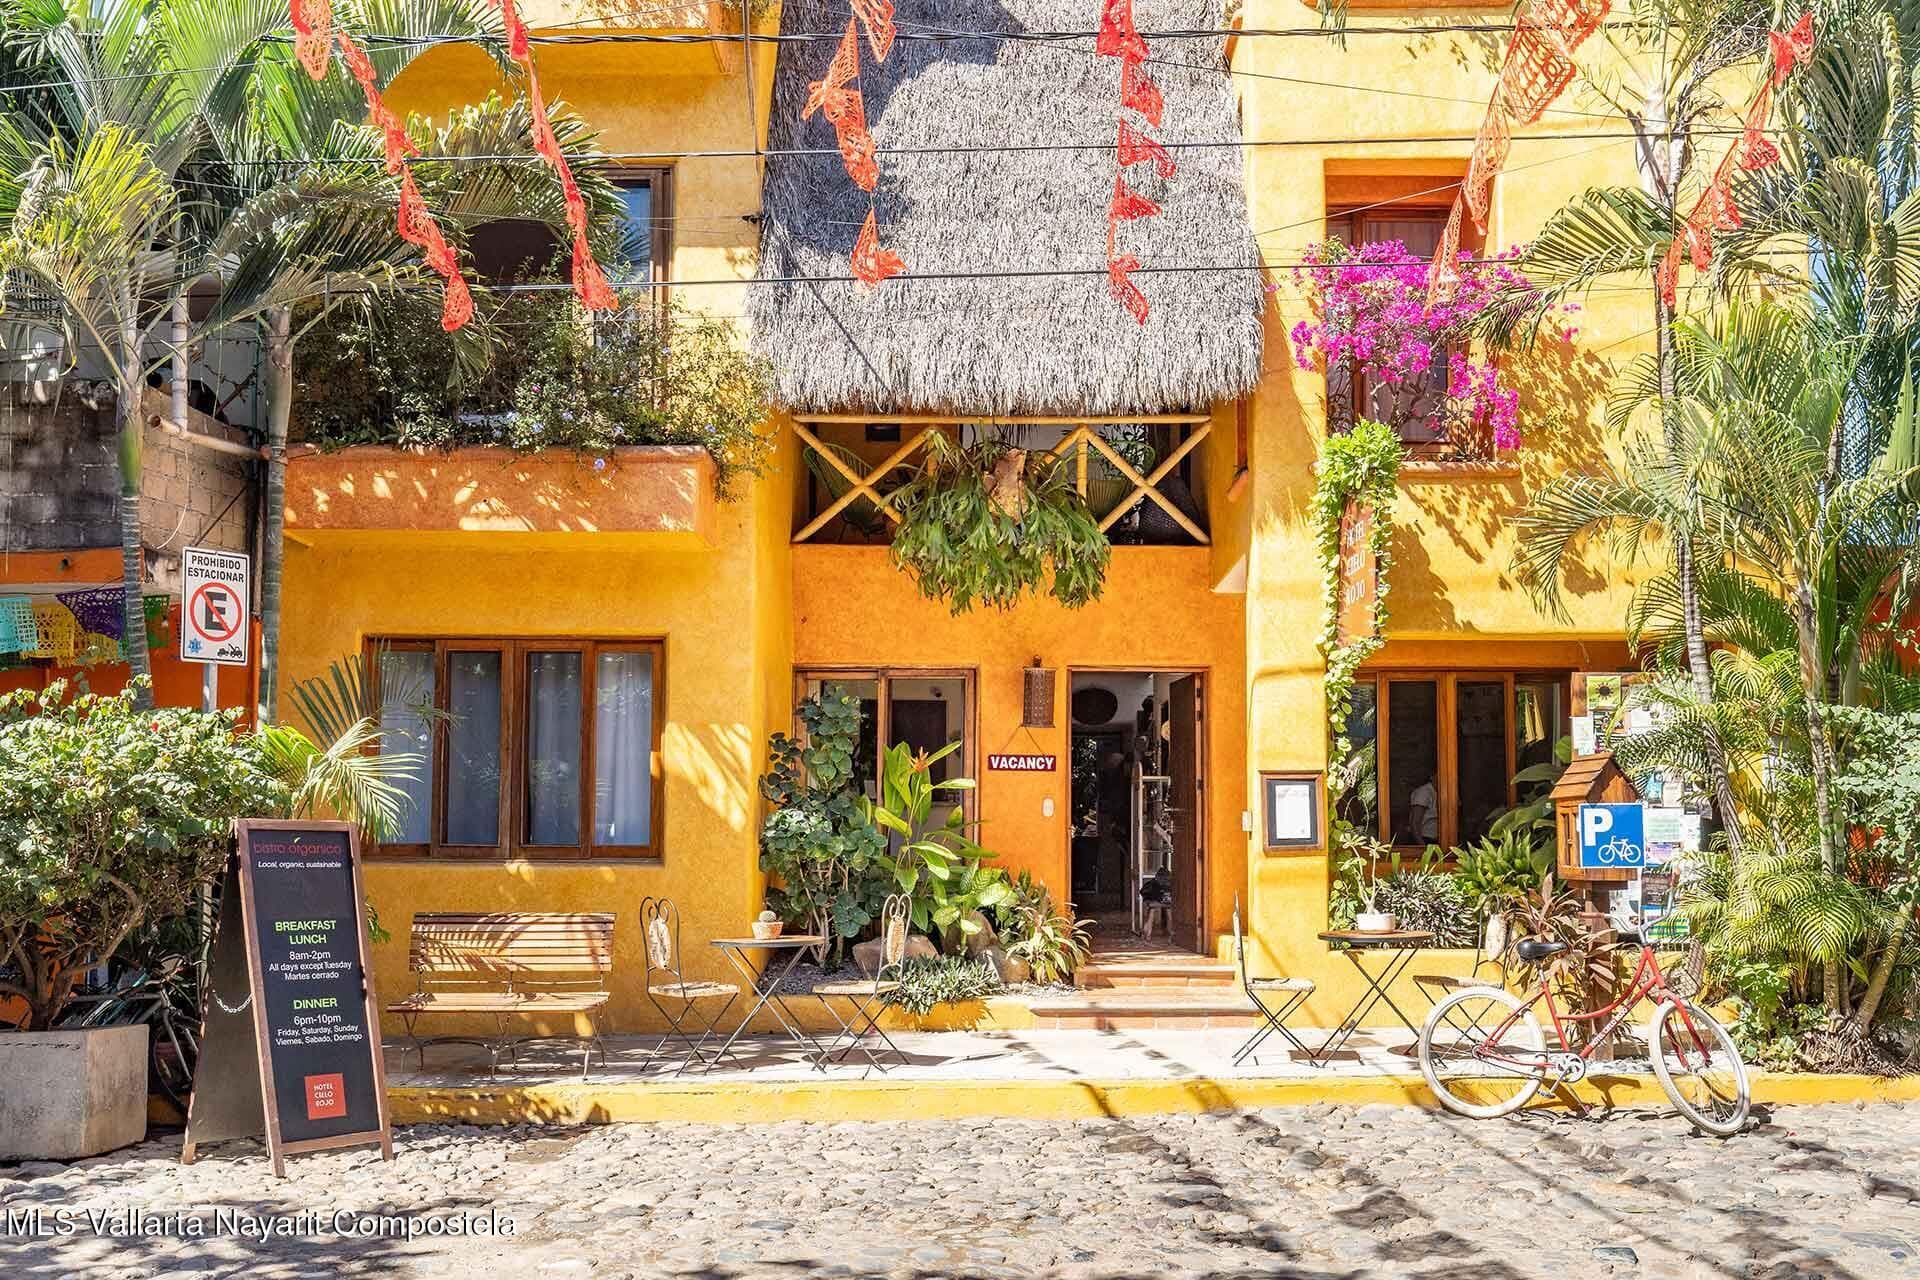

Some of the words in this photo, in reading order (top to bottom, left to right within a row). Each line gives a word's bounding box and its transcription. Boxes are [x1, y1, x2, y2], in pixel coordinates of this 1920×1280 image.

[191, 555, 241, 570] PROHIBIDO
[187, 567, 245, 583] ESTACIONAR
[990, 756, 1054, 770] VACANCY
[1584, 808, 1613, 847] P
[279, 861, 305, 870] organic,
[306, 861, 342, 869] sustainable
[275, 920, 336, 931] BREAKFAST
[289, 934, 327, 945] LUNCH
[289, 950, 331, 961] 8am-2pm
[269, 963, 279, 971] All
[280, 962, 299, 972] days
[300, 961, 323, 971] except
[324, 960, 352, 971] Tuesday
[284, 972, 310, 980] Martes
[311, 971, 340, 979] cerrado
[293, 997, 338, 1009] DINNER
[293, 1013, 342, 1027] 6pm-10pm
[277, 1028, 301, 1037] Friday,
[302, 1026, 333, 1036] Saturday,
[333, 1023, 359, 1033] Sunday
[275, 1036, 304, 1046] Viernes,
[333, 1032, 363, 1042] Domingo
[313, 1082, 333, 1091] HOTEL
[314, 1090, 333, 1099] CIELO
[315, 1098, 335, 1107] ROJO
